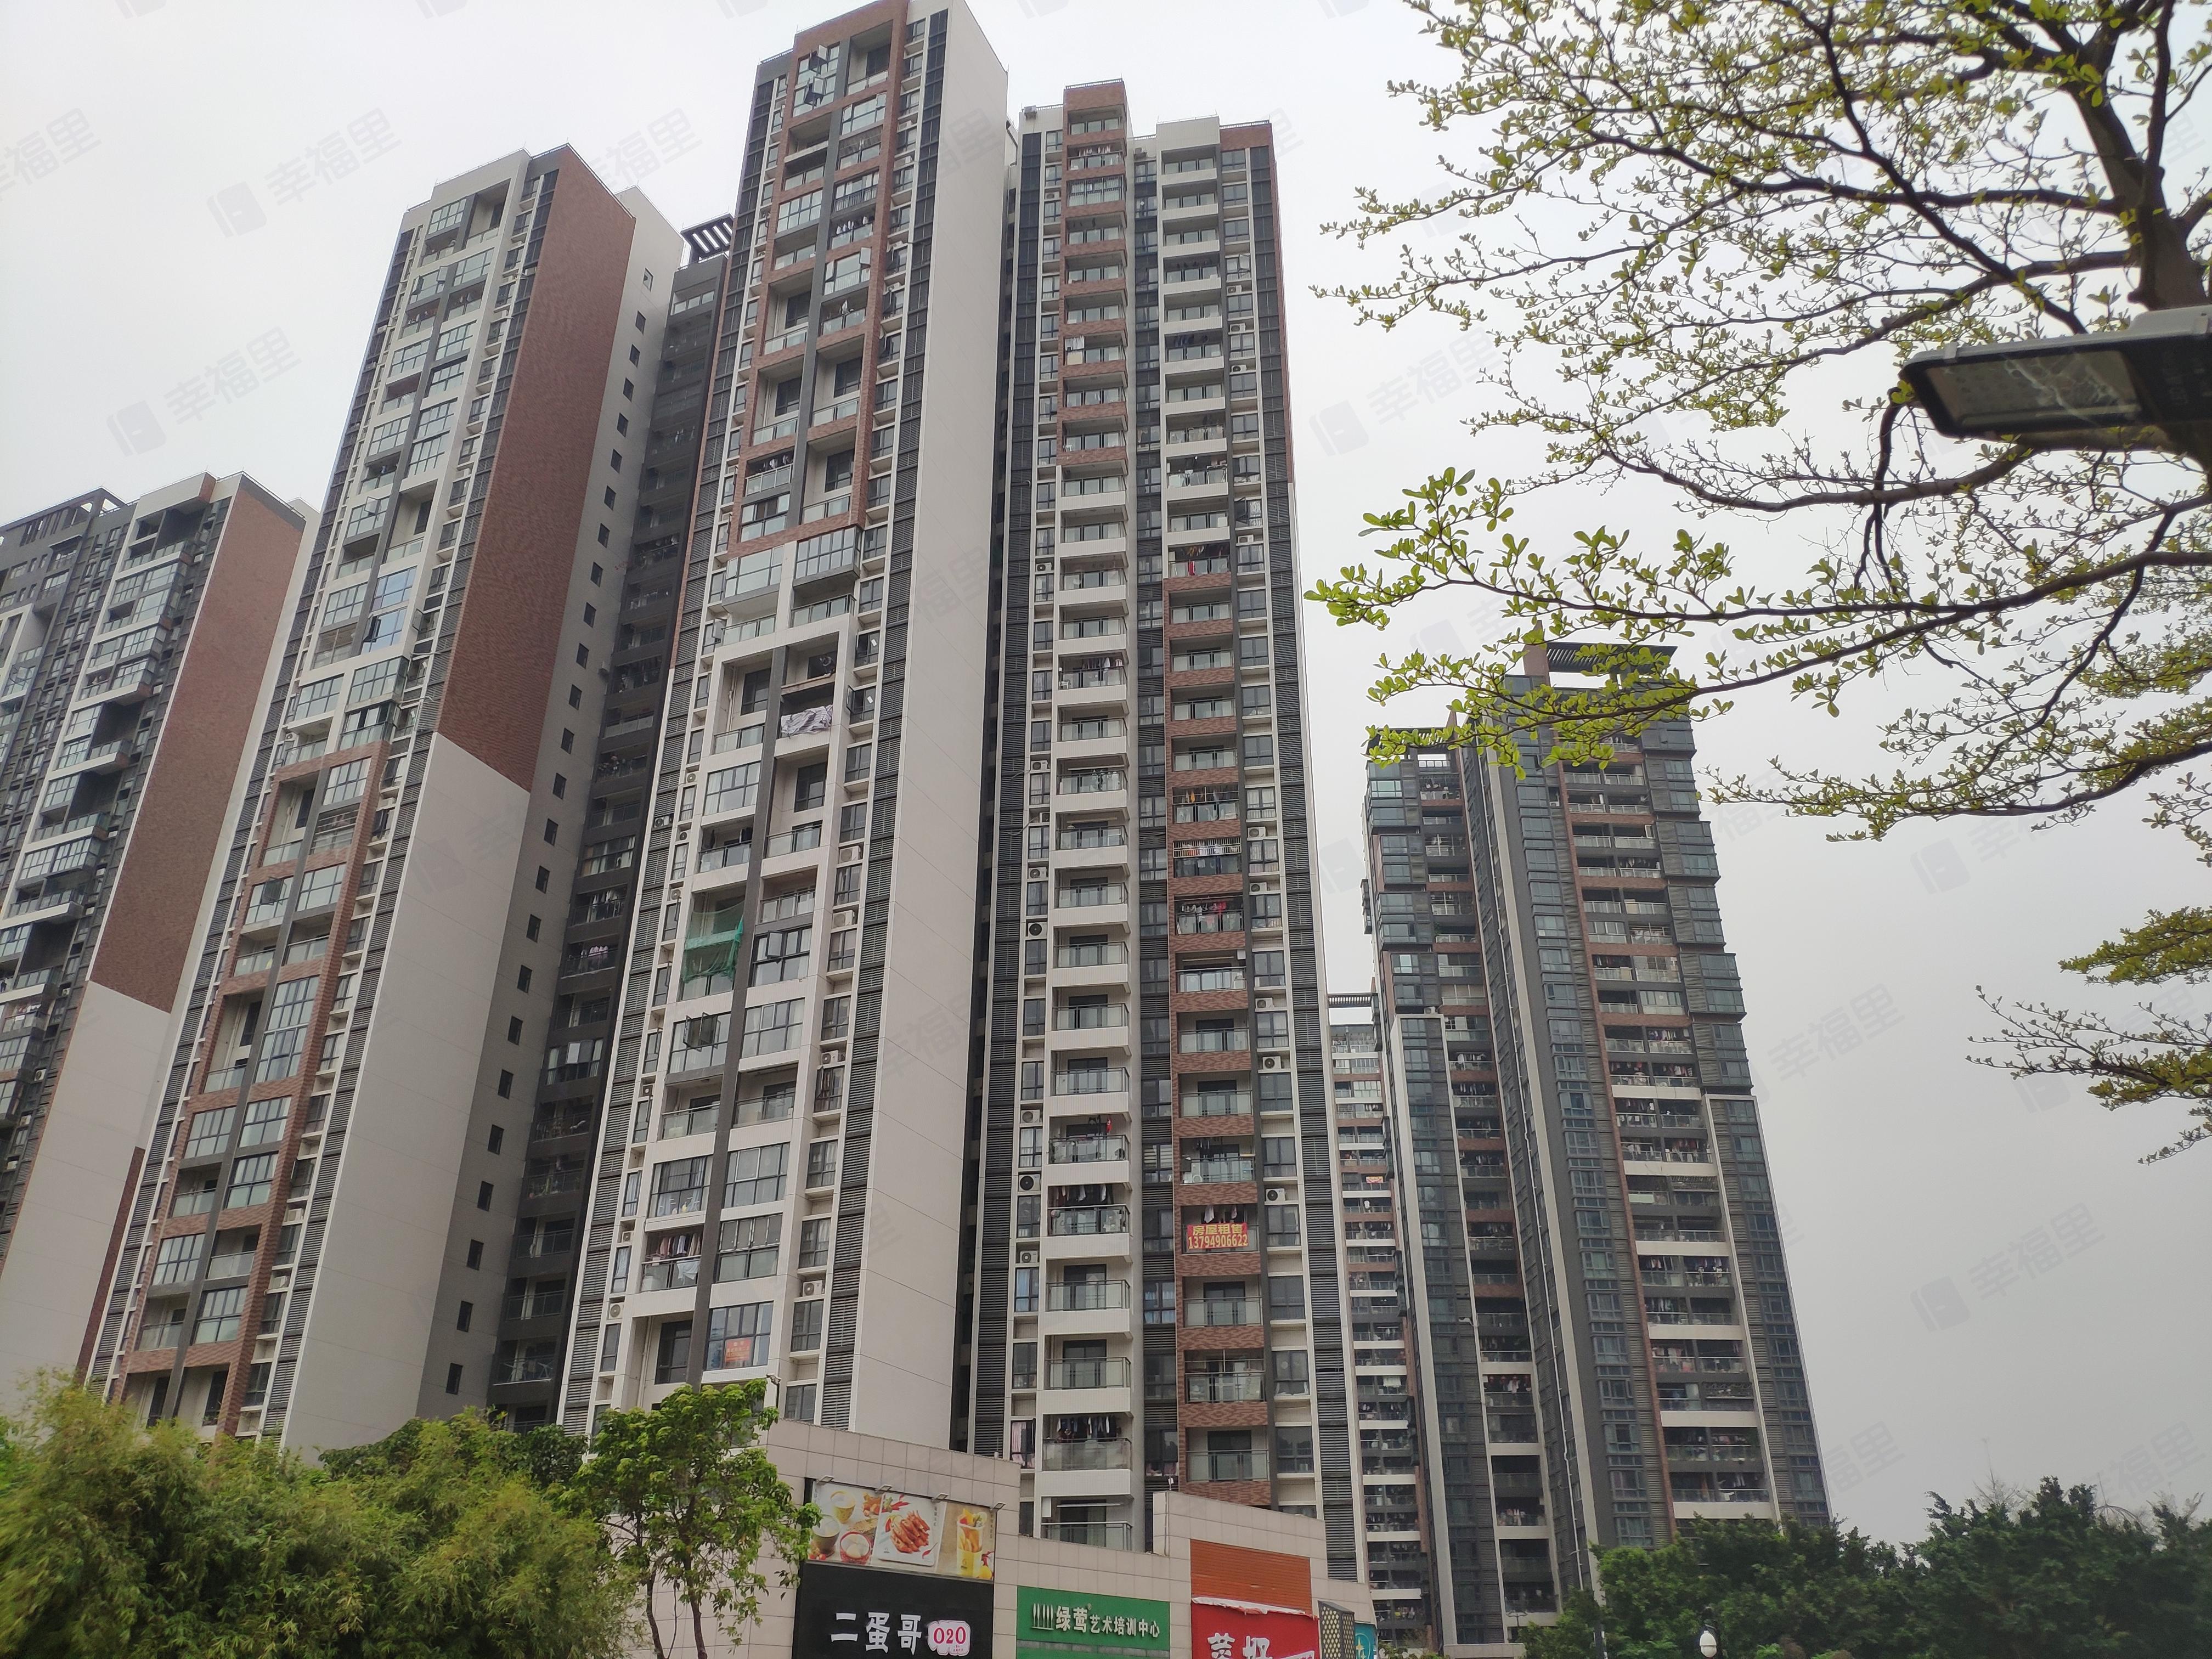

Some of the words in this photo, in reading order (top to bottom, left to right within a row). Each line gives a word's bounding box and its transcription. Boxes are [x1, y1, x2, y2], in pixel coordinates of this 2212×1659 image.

[1192, 1224, 1243, 1235] 房屋租售
[1188, 1234, 1249, 1249] 13794906622
[831, 1612, 922, 1656] 二蛋哥
